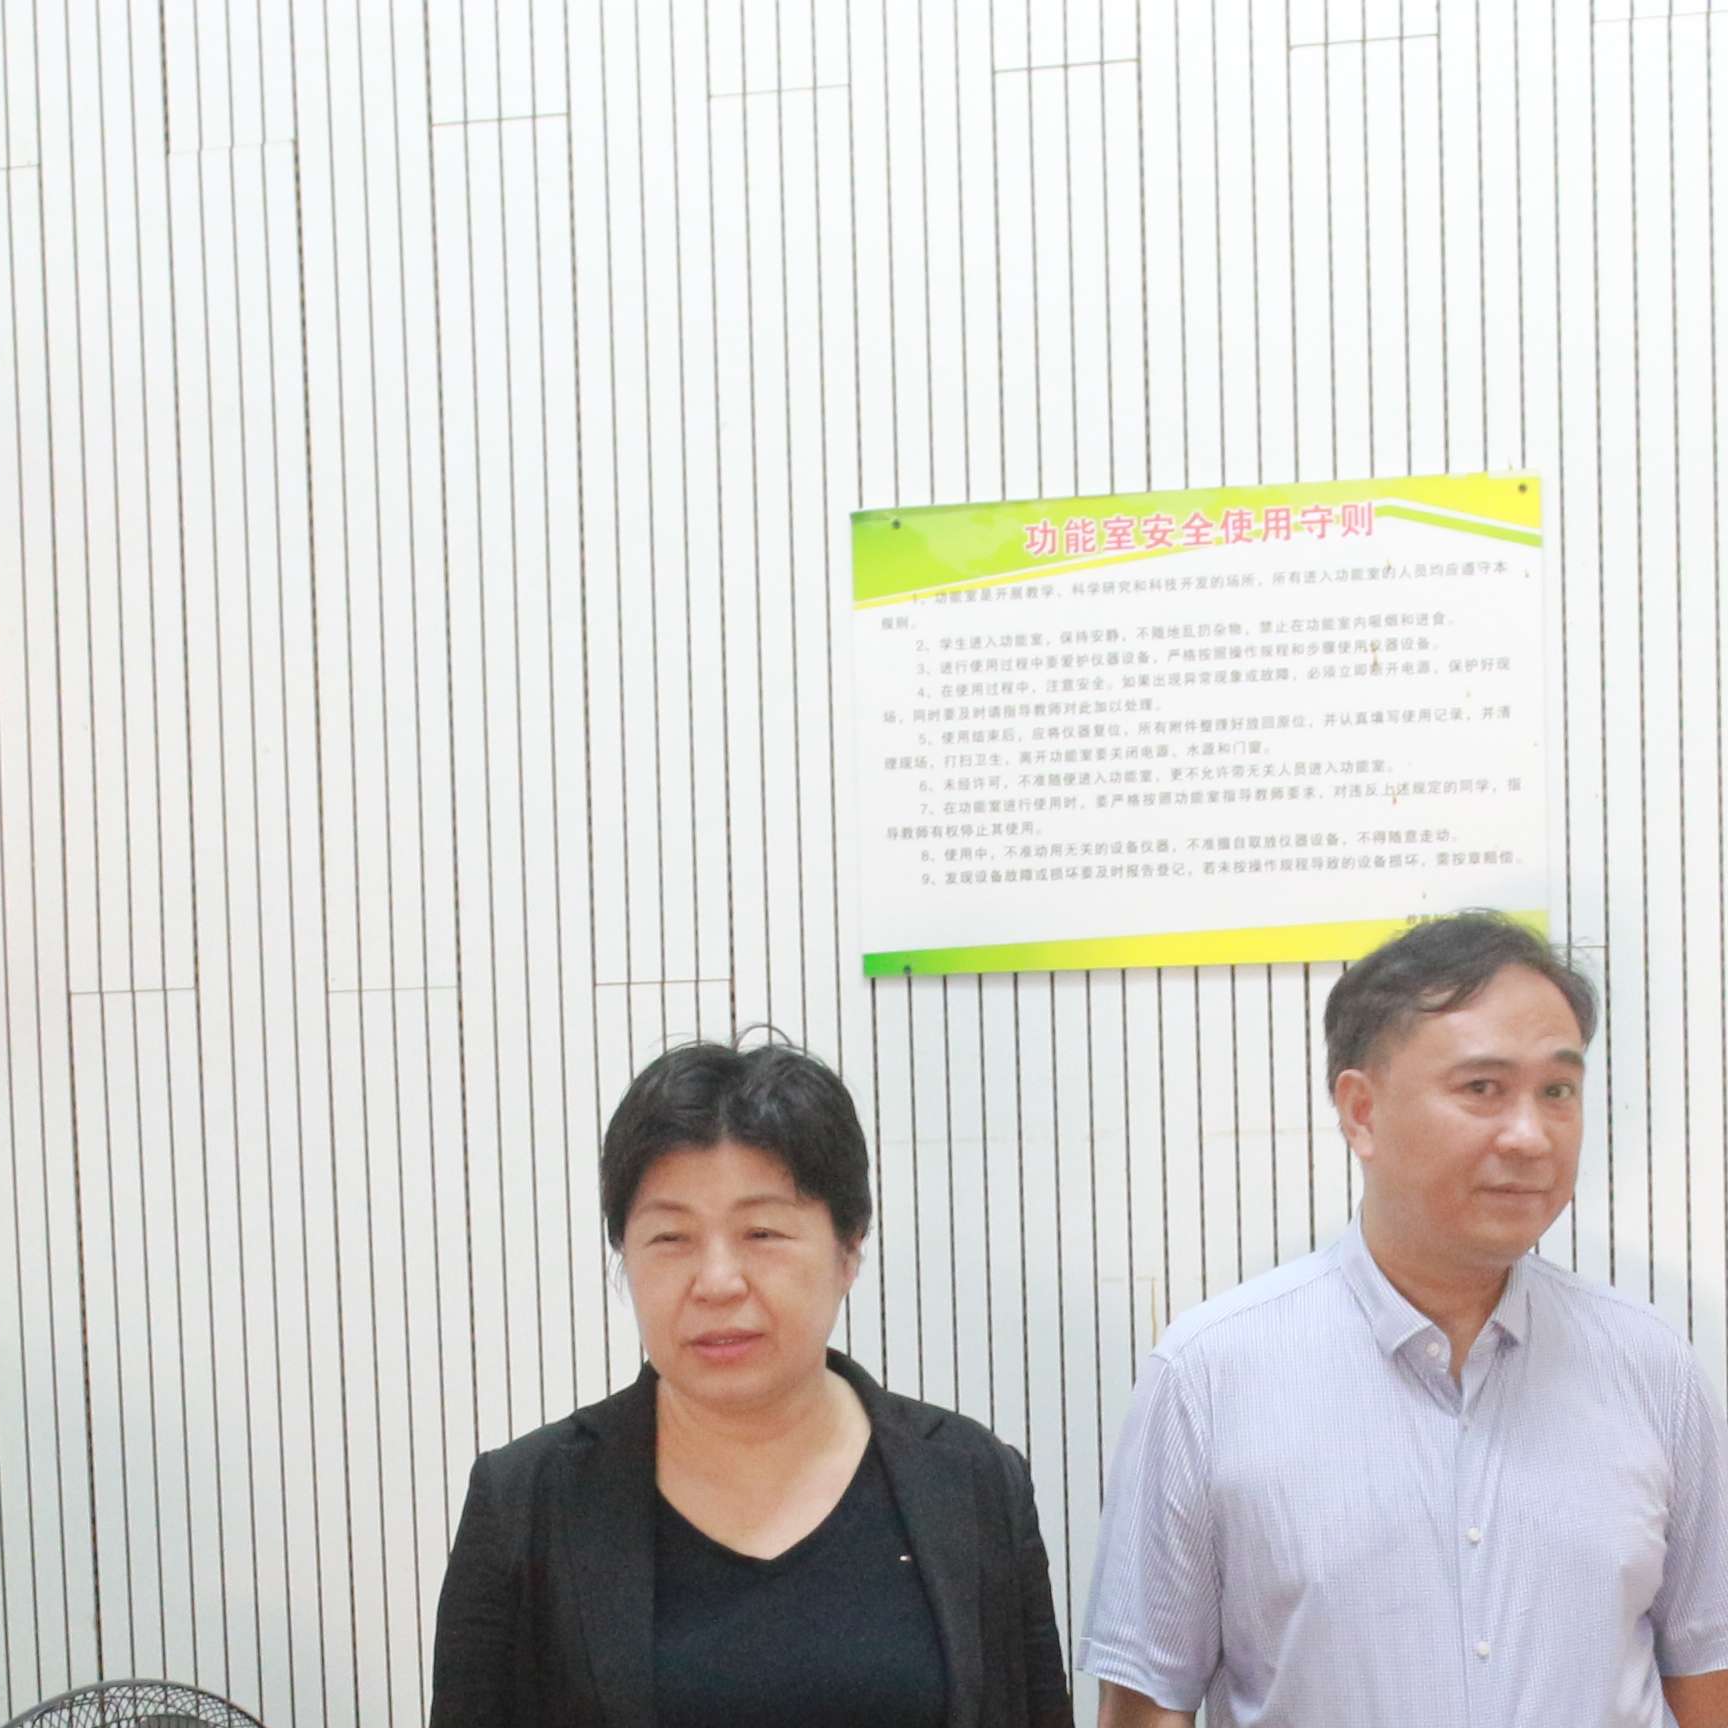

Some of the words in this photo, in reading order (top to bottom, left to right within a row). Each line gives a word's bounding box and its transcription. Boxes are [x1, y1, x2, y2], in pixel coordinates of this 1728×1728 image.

[1025, 502, 1375, 555] 功能室安全使用守则
